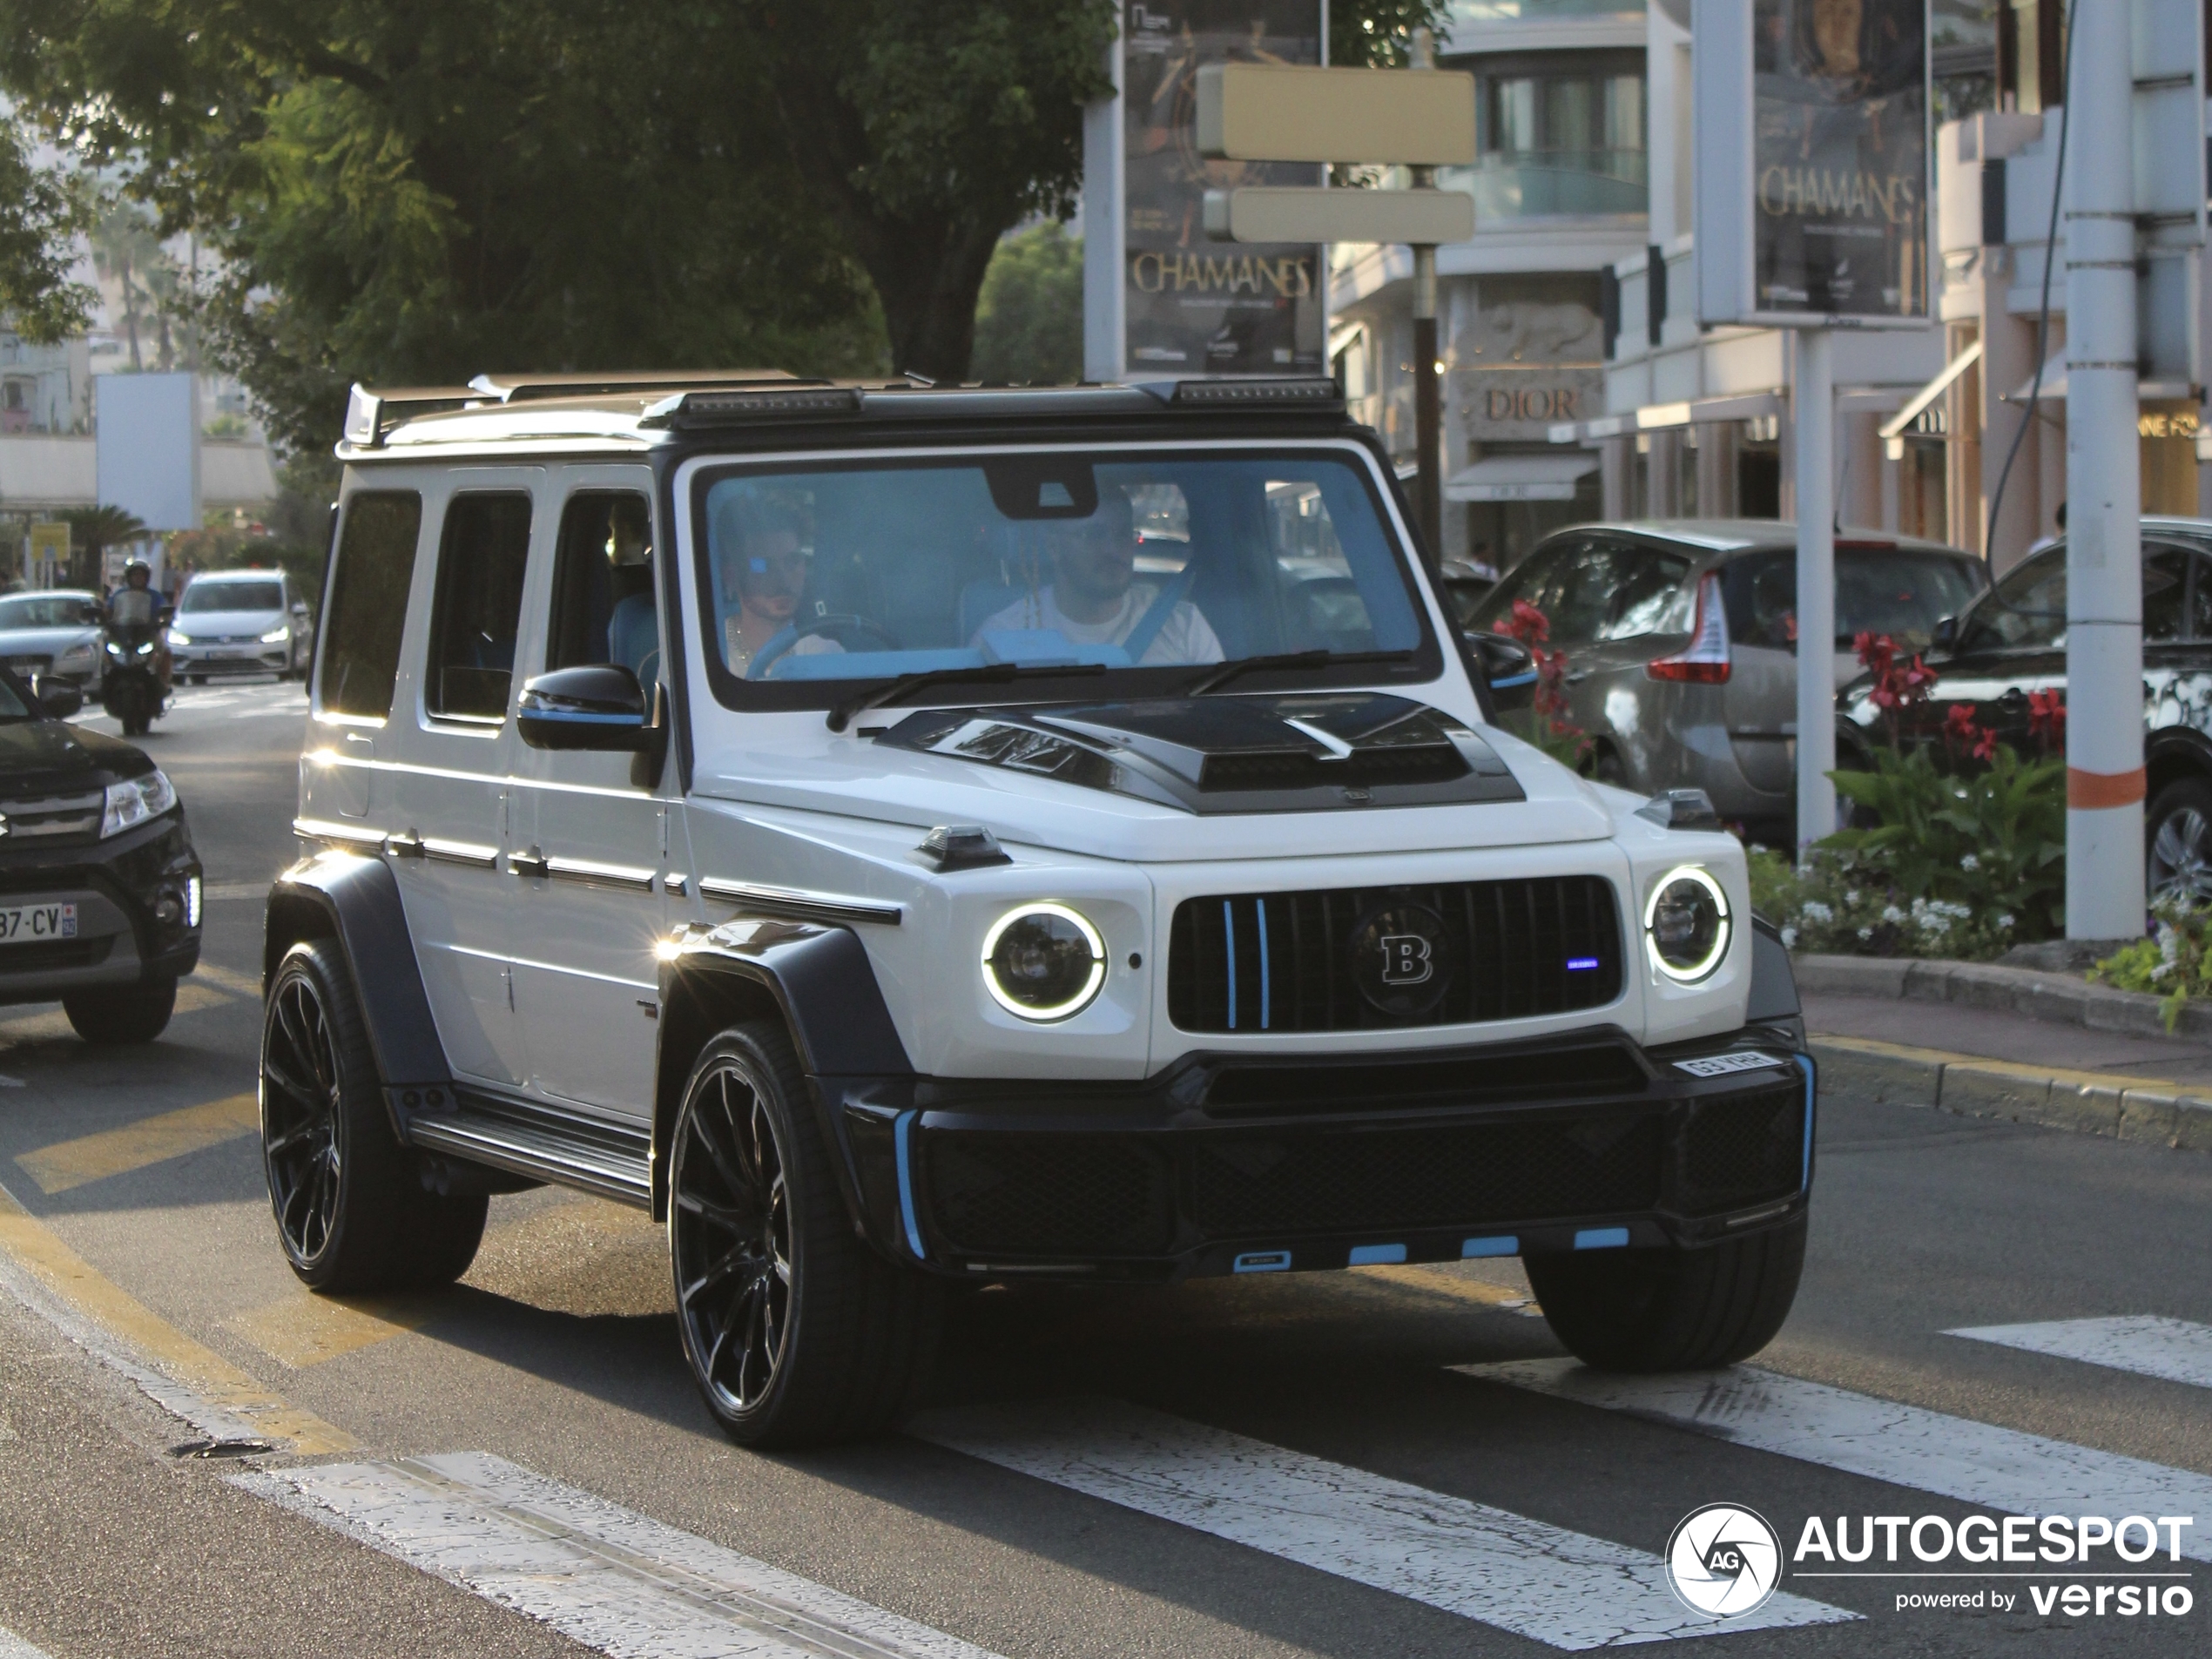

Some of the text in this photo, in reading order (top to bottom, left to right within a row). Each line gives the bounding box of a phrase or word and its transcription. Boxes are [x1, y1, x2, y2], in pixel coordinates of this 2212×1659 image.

[1759, 165, 1916, 224] CHAMANES
[1134, 253, 1311, 297] CHAMANES
[1486, 388, 1579, 420] DIOR
[1380, 934, 1433, 985] B
[1686, 1060, 1725, 1074] G3
